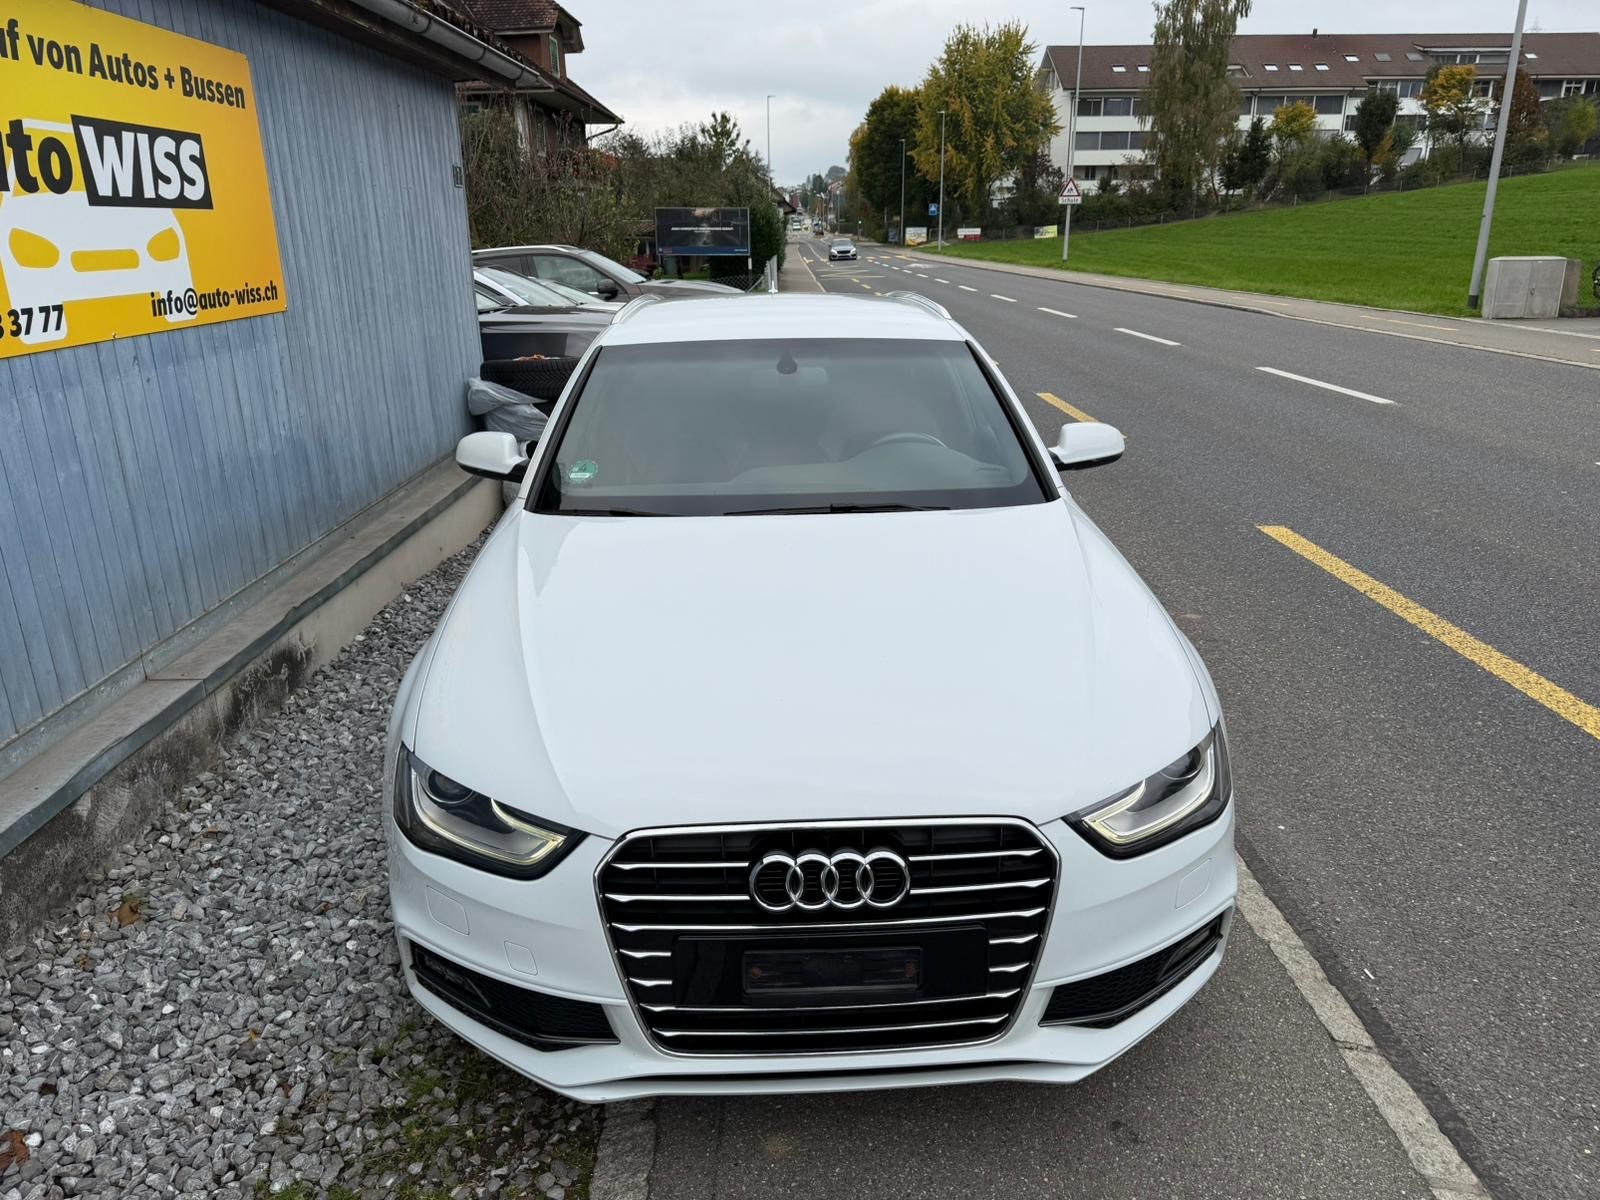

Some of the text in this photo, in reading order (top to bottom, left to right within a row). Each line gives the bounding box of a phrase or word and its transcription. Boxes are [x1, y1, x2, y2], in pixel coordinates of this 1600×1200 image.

[26, 33, 83, 75] von
[89, 43, 159, 90] Autos
[164, 67, 175, 89] +
[180, 66, 246, 109] Bussen
[79, 125, 206, 201] WISS
[38, 304, 64, 333] 77
[150, 280, 279, 317] info@auto-wiss.ch
